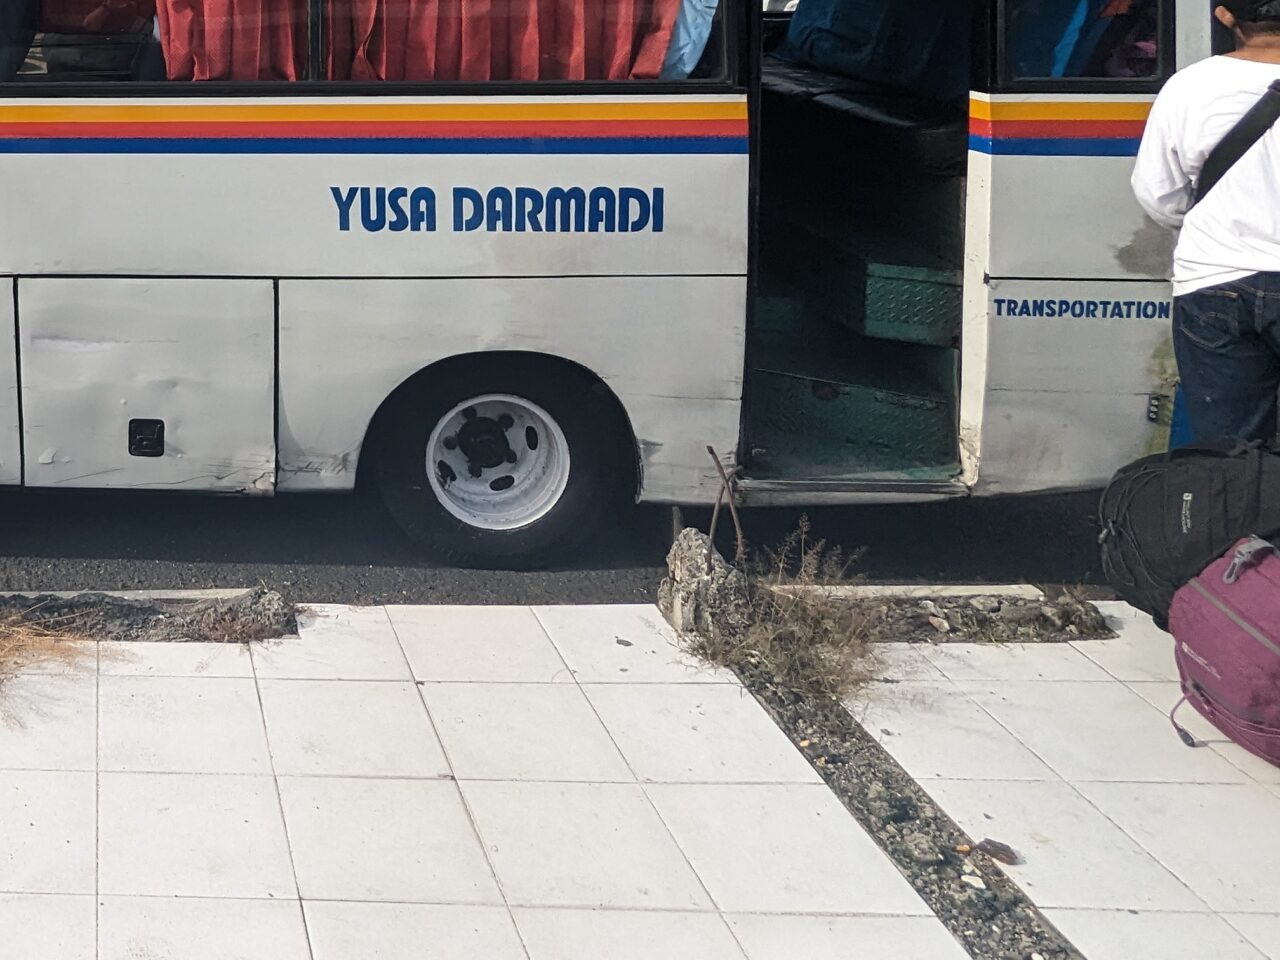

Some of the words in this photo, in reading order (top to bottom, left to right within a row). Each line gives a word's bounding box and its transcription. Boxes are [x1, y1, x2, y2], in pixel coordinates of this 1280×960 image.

[329, 186, 436, 232] YUSA
[452, 186, 664, 233] DARMADI
[993, 299, 1170, 319] TRANSPORTATION
